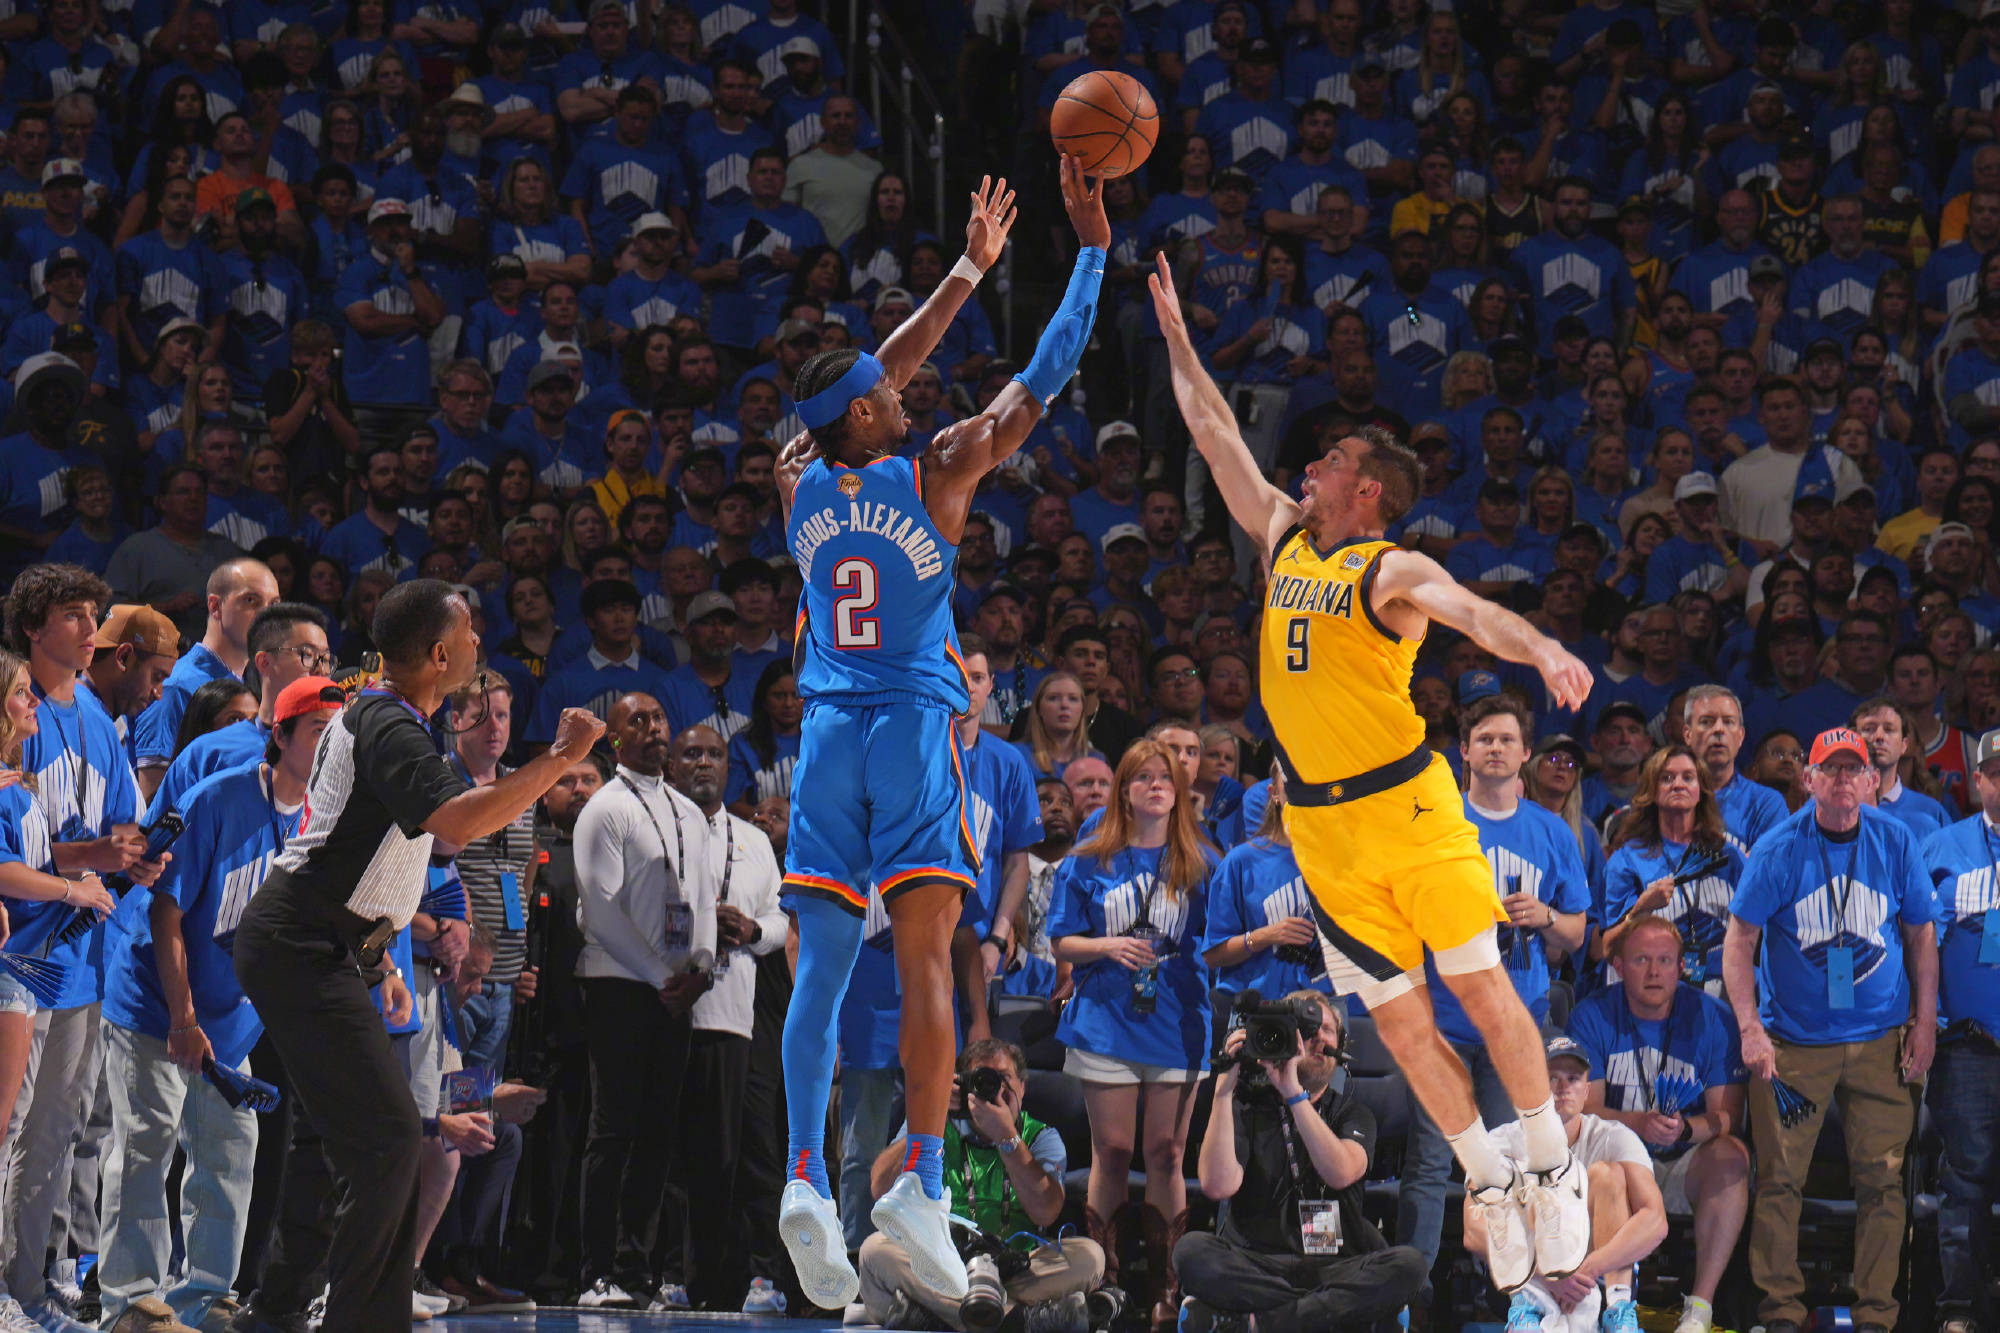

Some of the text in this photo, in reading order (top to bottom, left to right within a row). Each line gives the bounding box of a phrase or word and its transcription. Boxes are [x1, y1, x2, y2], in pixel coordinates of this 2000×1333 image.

[832, 556, 880, 649] 2
[1286, 617, 1311, 673] 9
[1822, 729, 1861, 748] OKC
